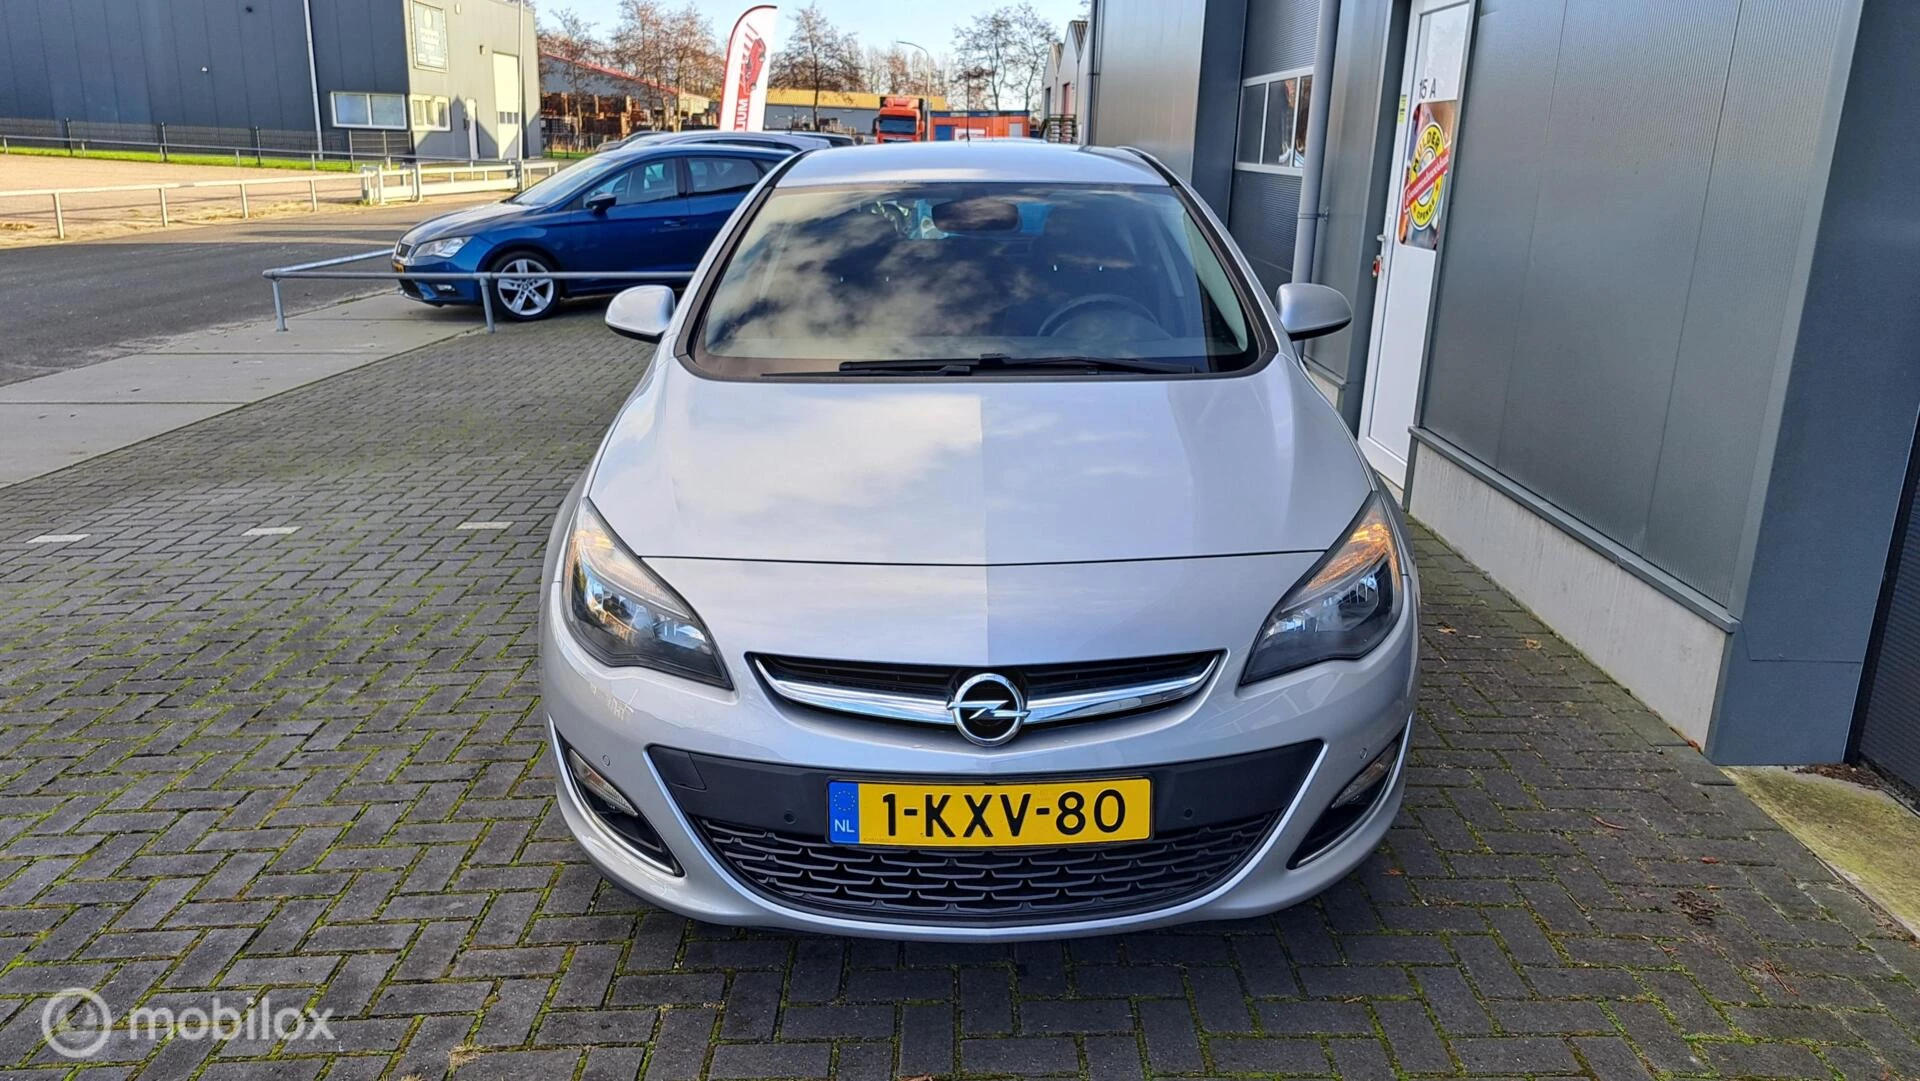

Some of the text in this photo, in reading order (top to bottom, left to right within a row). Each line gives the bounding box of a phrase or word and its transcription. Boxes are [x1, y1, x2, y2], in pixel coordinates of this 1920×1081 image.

[1419, 78, 1437, 99] 15 A
[882, 789, 1126, 837] 1-KXV-80
[834, 819, 855, 833] NL
